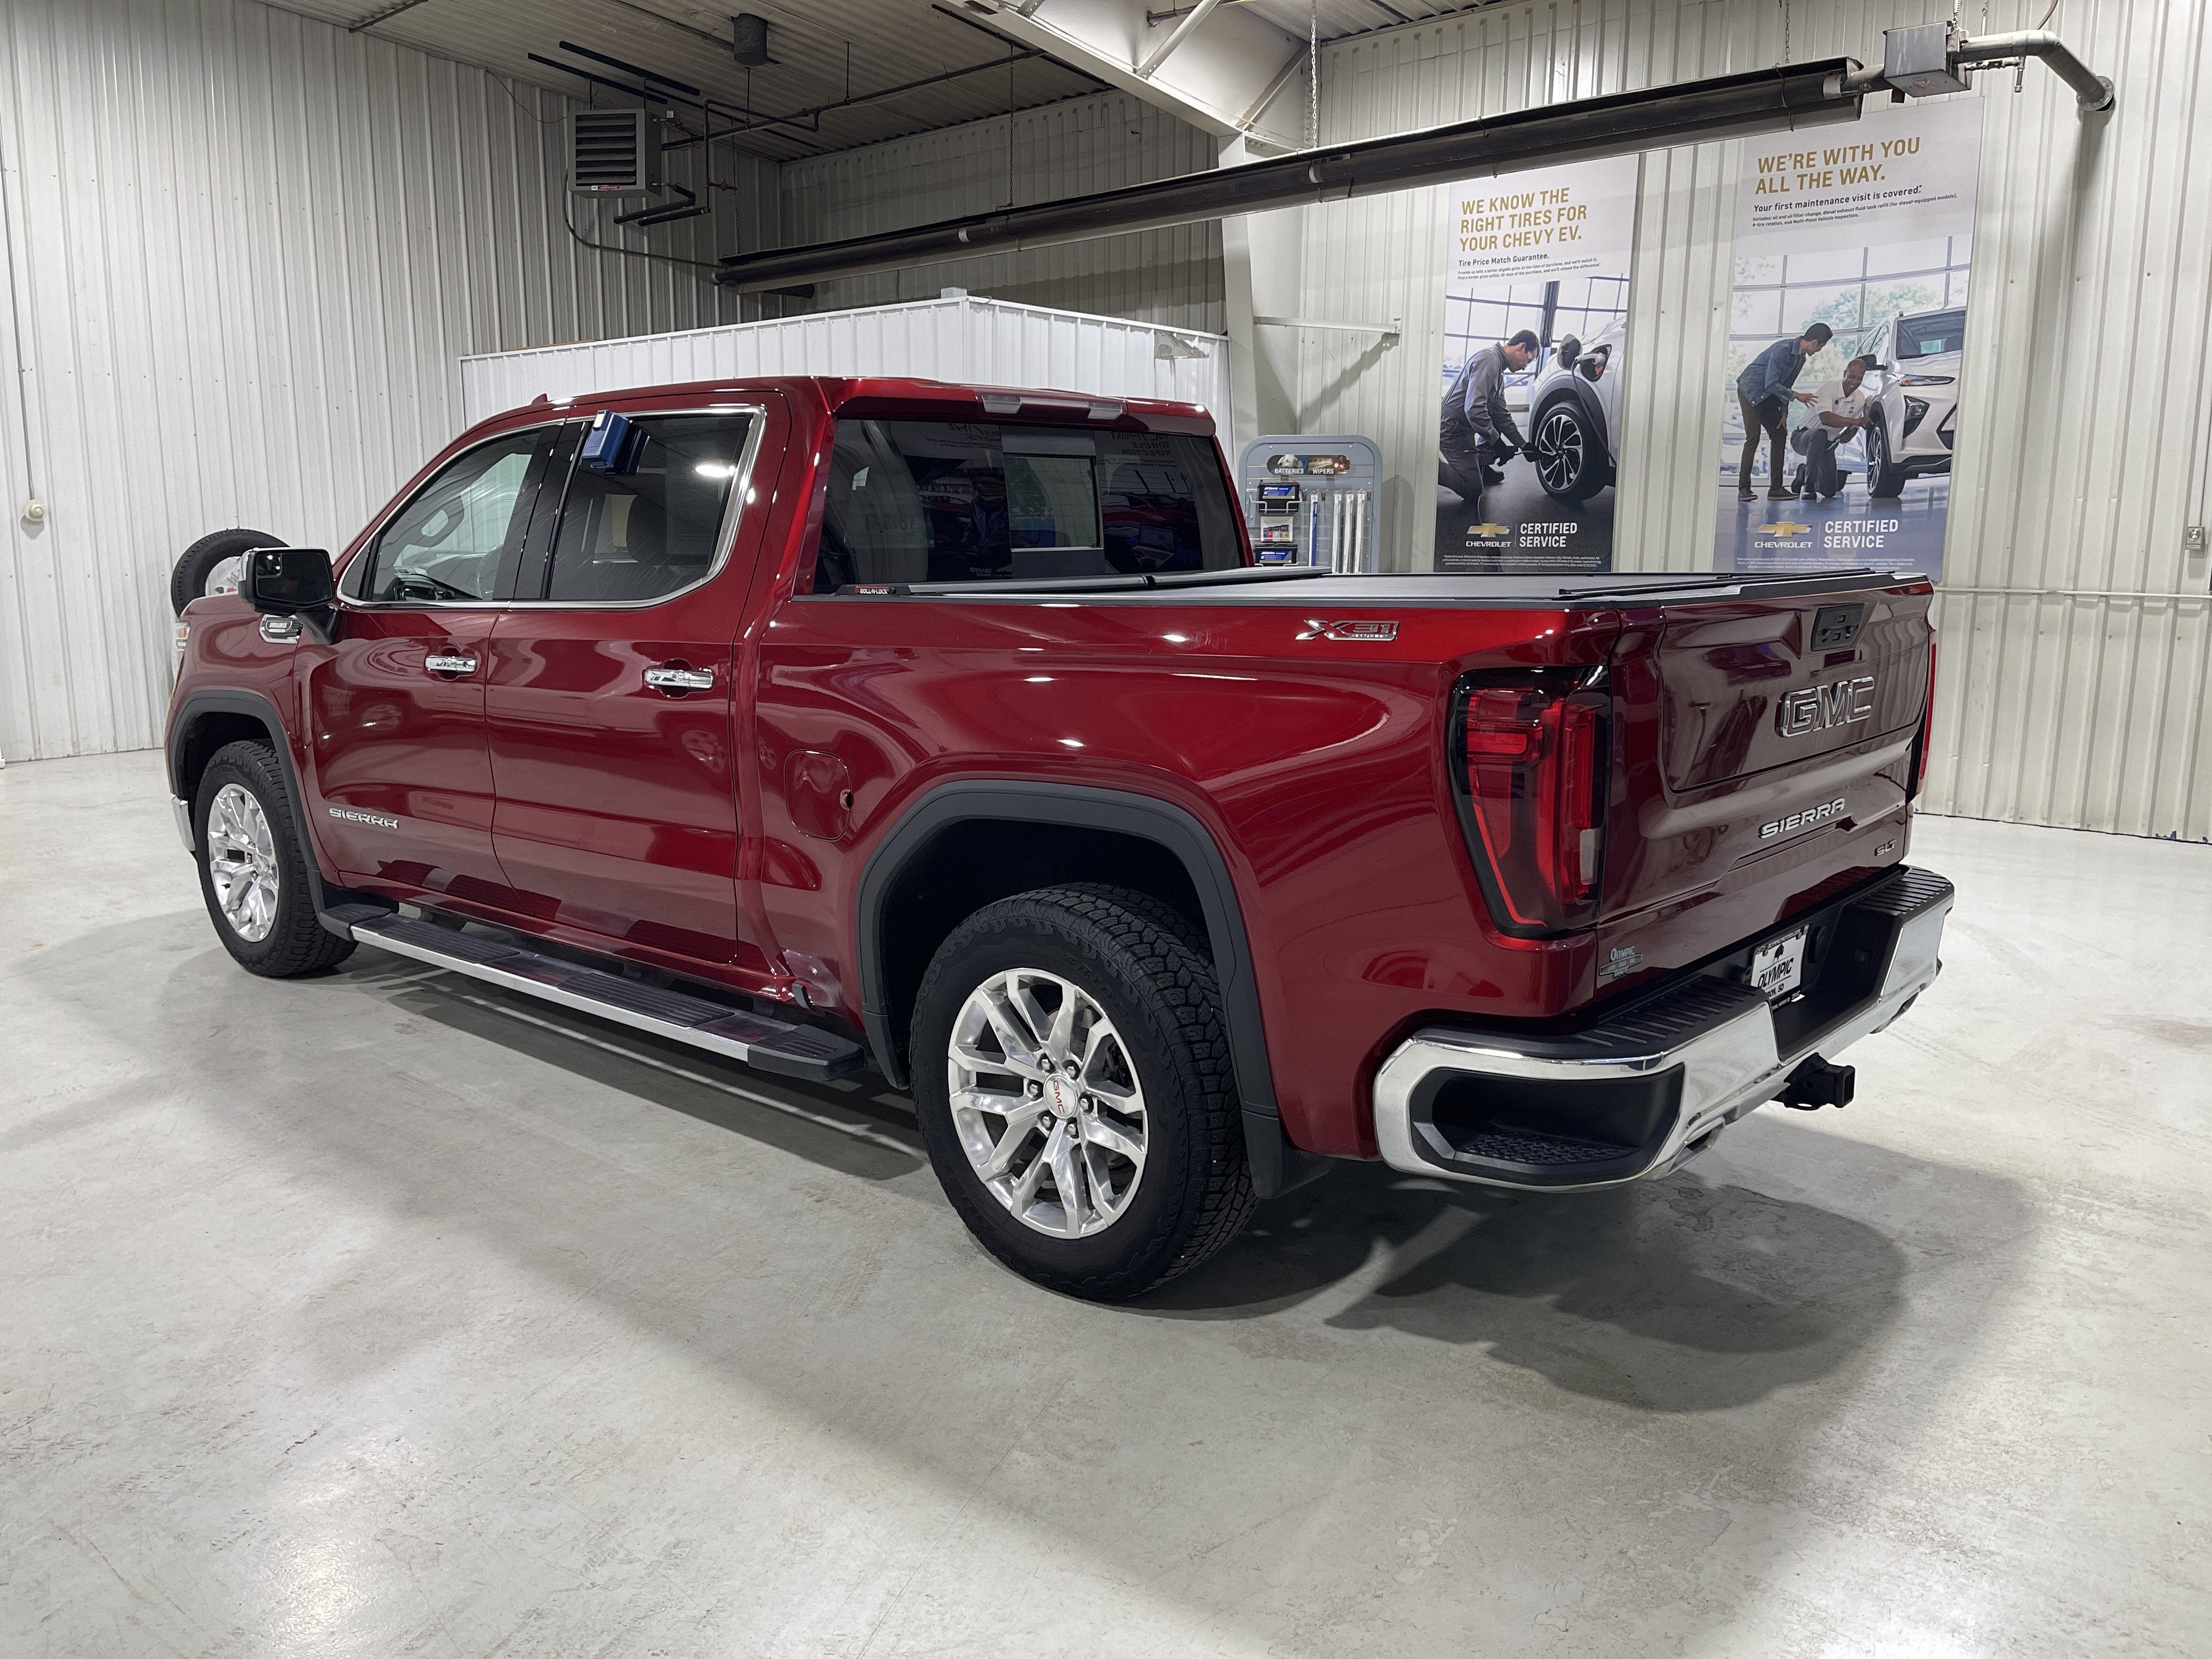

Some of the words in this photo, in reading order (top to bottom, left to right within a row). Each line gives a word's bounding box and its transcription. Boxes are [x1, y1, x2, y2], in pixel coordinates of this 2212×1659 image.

[1758, 151, 1817, 173] WE'RE
[1823, 144, 1874, 166] WITH
[1881, 137, 1920, 158] YOU
[1756, 176, 1790, 195] ALL
[1797, 171, 1833, 190] THE
[1839, 164, 1885, 185] WAY.
[1462, 199, 1485, 215] WE
[1489, 193, 1535, 213] KNOW
[1539, 188, 1570, 205] THE
[1795, 196, 1849, 208] maintenance
[1852, 193, 1870, 202] visit
[1460, 216, 1504, 234] RIGHT
[1509, 210, 1552, 228] TIRES
[1558, 205, 1587, 223] FOR
[1460, 235, 1498, 252] YOUR
[1503, 228, 1554, 248] CHEVY
[1559, 225, 1581, 242] EV.
[1513, 253, 1549, 262] Guarantee.
[1520, 522, 1577, 534] CERTIFIED
[1825, 519, 1899, 533] CERTIFIED
[1519, 536, 1567, 548] SERVICE
[1824, 535, 1884, 549] SERVICE
[1775, 676, 1875, 738] GMC
[329, 808, 398, 828] SIERRA
[1758, 797, 1845, 839] SIERRA
[1874, 838, 1897, 856] SLT
[1758, 958, 1793, 988] OLYMPIC
[1053, 1080, 1065, 1114] GMC
